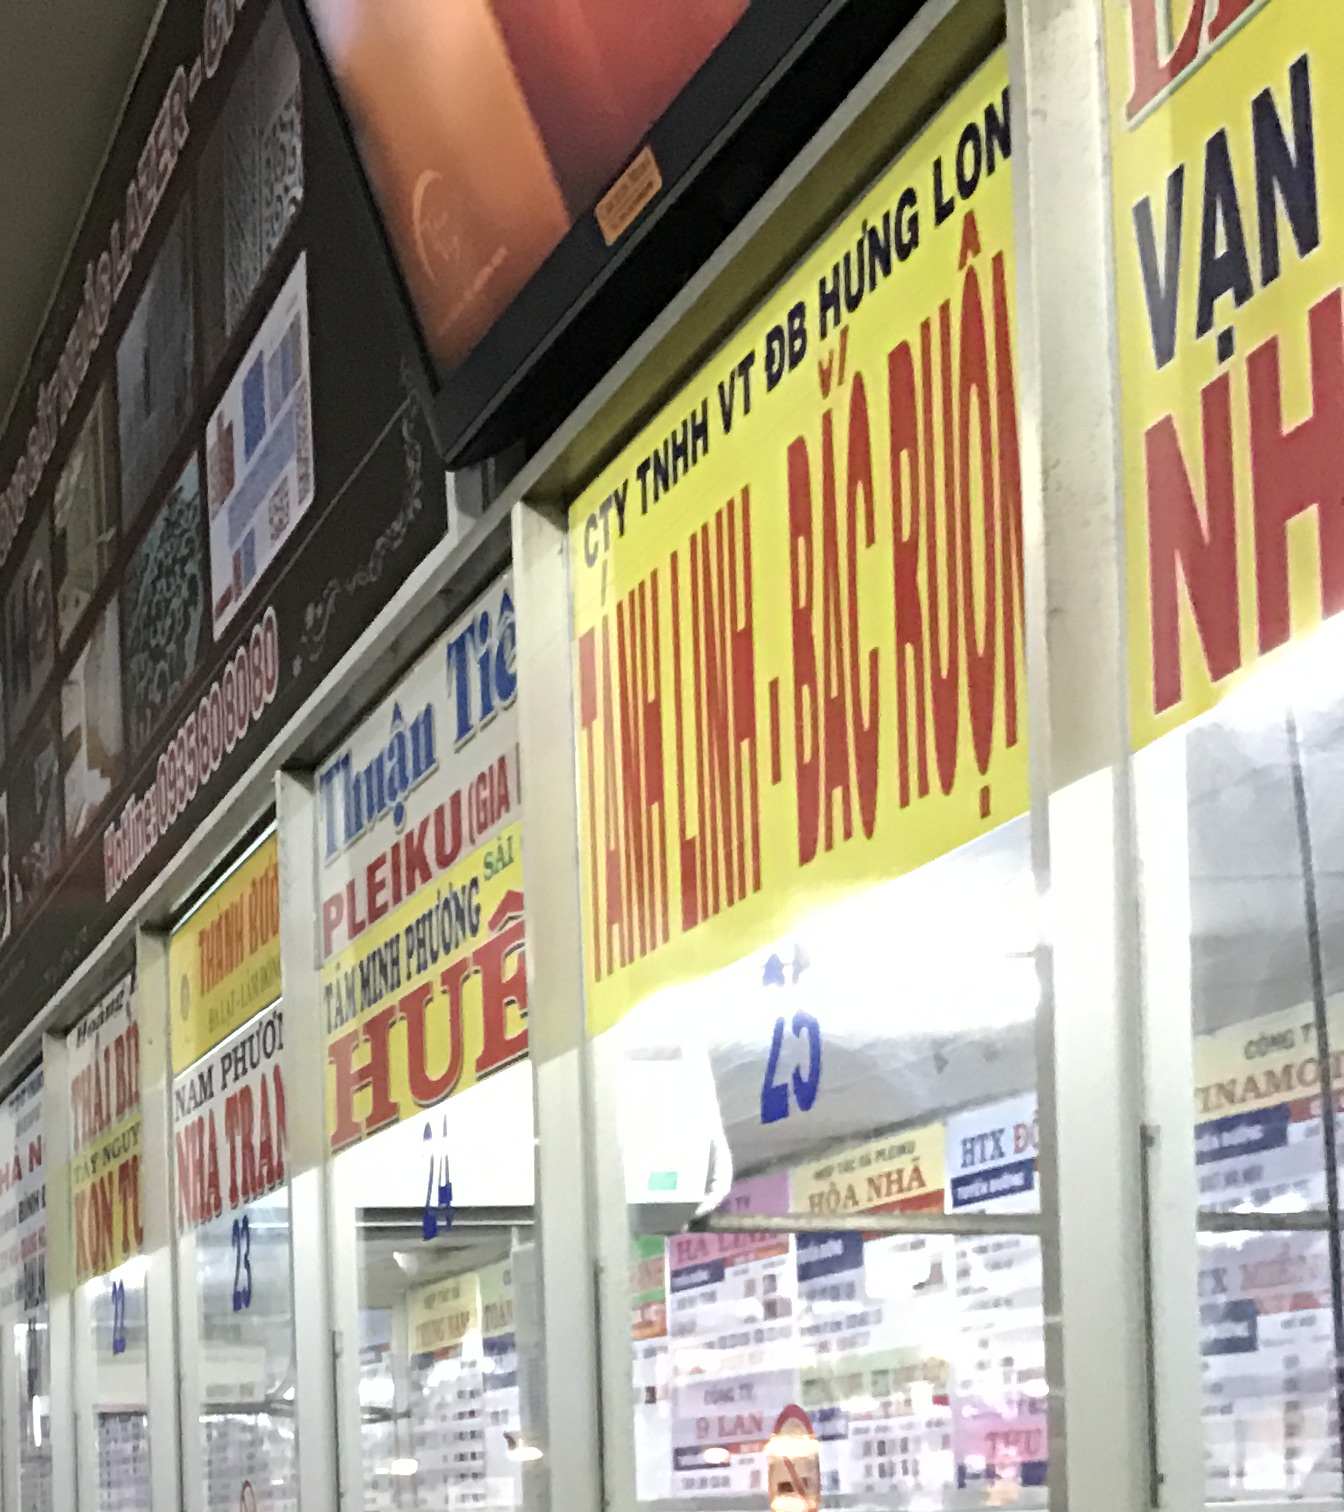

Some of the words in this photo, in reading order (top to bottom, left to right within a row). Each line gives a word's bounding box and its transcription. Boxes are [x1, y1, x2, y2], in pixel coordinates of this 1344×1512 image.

[1132, 53, 1320, 370] VẠN
[584, 478, 628, 568] CTY
[636, 397, 708, 515] TNHH
[719, 350, 755, 434] VT
[765, 301, 807, 391] ĐB
[671, 484, 761, 932] LINH
[787, 326, 881, 867] BẮC
[319, 702, 436, 859] Thuận
[323, 791, 461, 958] PLEIKU
[359, 932, 401, 1011] MINH
[175, 1064, 214, 1123] NAM
[177, 1111, 222, 1233] NHA
[961, 1128, 1005, 1168] HTX
